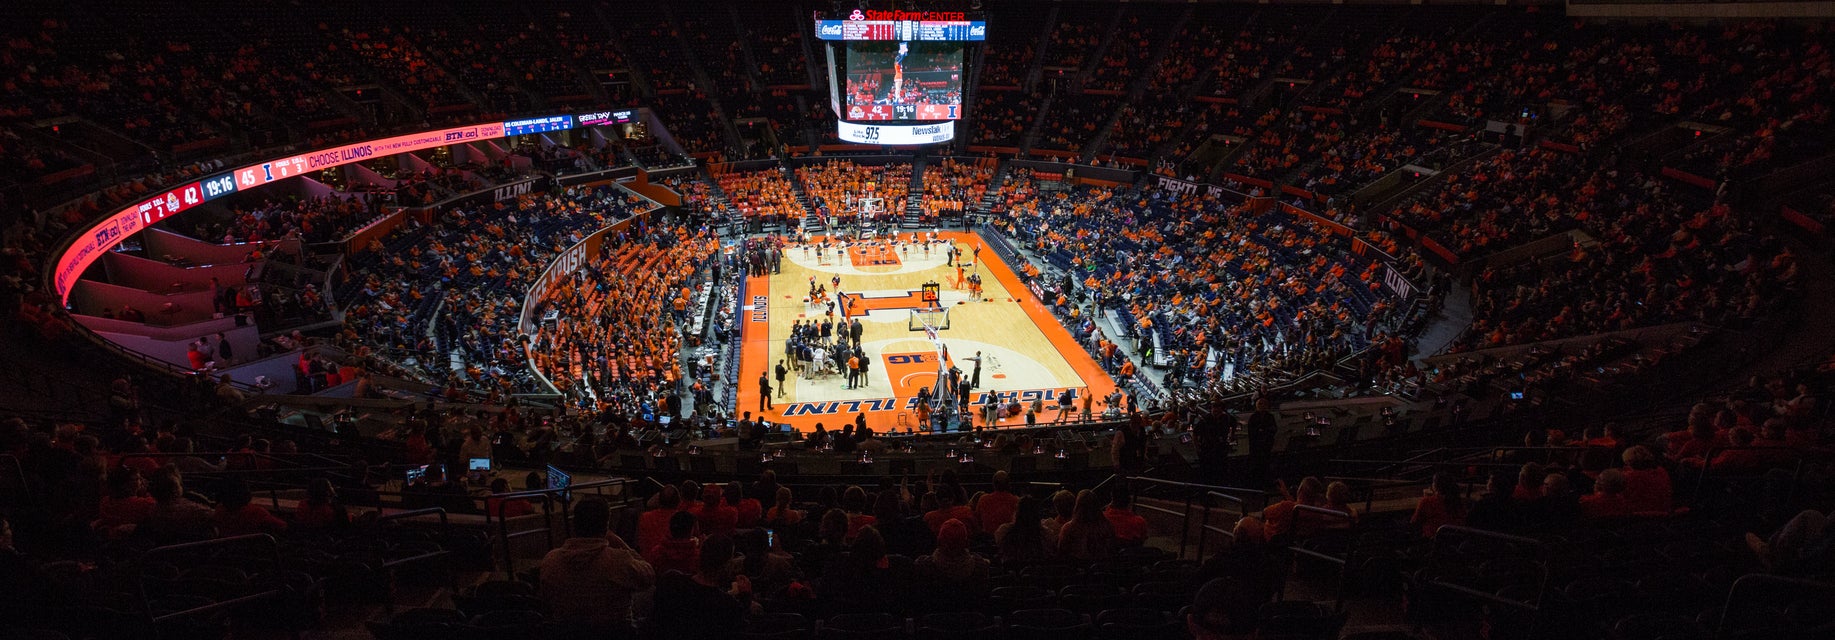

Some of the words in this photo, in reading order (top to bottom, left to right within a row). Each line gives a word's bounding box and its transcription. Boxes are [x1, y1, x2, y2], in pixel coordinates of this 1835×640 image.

[922, 11, 965, 21] CENTER
[872, 105, 883, 114] 42
[309, 151, 340, 168] CHOOSE
[341, 145, 373, 161] ILLINOIS
[206, 176, 233, 197] 19:16
[241, 169, 256, 186] 45
[184, 187, 199, 205] 42
[495, 182, 532, 202] ILLINI
[1385, 268, 1410, 300] ILLINI
[753, 295, 768, 322] ILLINOIS
[782, 398, 898, 417] ILLINI
